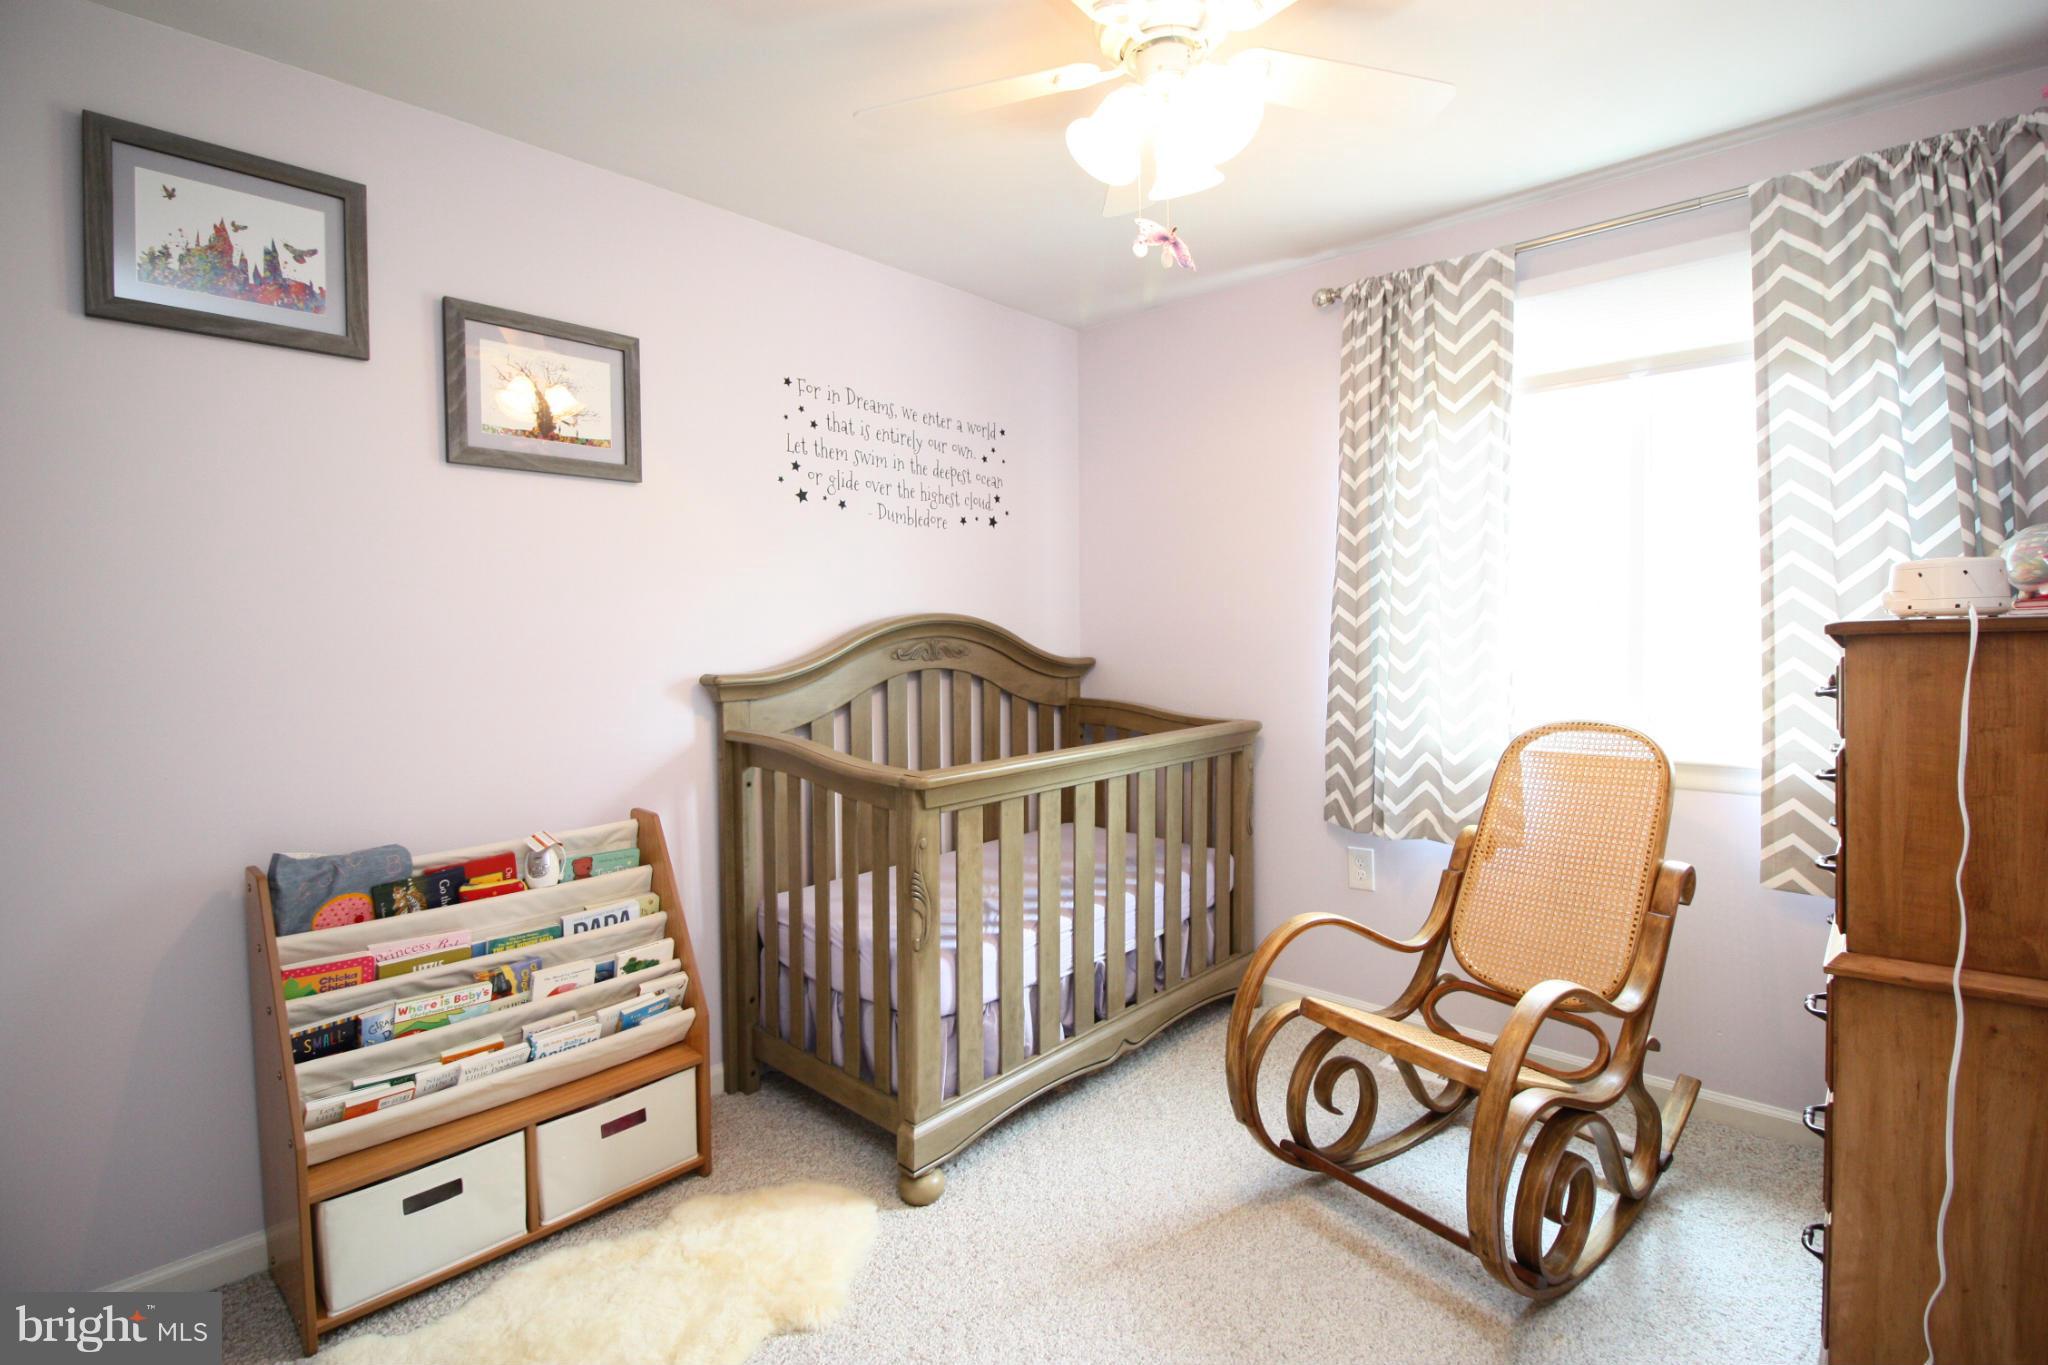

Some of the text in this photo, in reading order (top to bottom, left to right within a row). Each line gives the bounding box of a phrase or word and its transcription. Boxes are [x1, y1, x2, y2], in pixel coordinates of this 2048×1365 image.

[797, 378, 997, 441] For in Dreams, we enter a world
[826, 411, 855, 436] that
[861, 420, 871, 441] is
[876, 428, 922, 454] entirely
[928, 439, 948, 454] our
[786, 433, 1004, 489] Let them swim in the deepest ocean
[807, 470, 823, 486] or
[826, 469, 860, 496] glide
[865, 480, 892, 496] over
[897, 479, 915, 500] the
[920, 482, 960, 510] highest
[877, 502, 948, 529] Dumbledore
[439, 879, 450, 894] Go
[319, 973, 358, 985] Chicka
[398, 988, 490, 1016] Where is Baby's
[303, 1030, 344, 1053] SMALL
